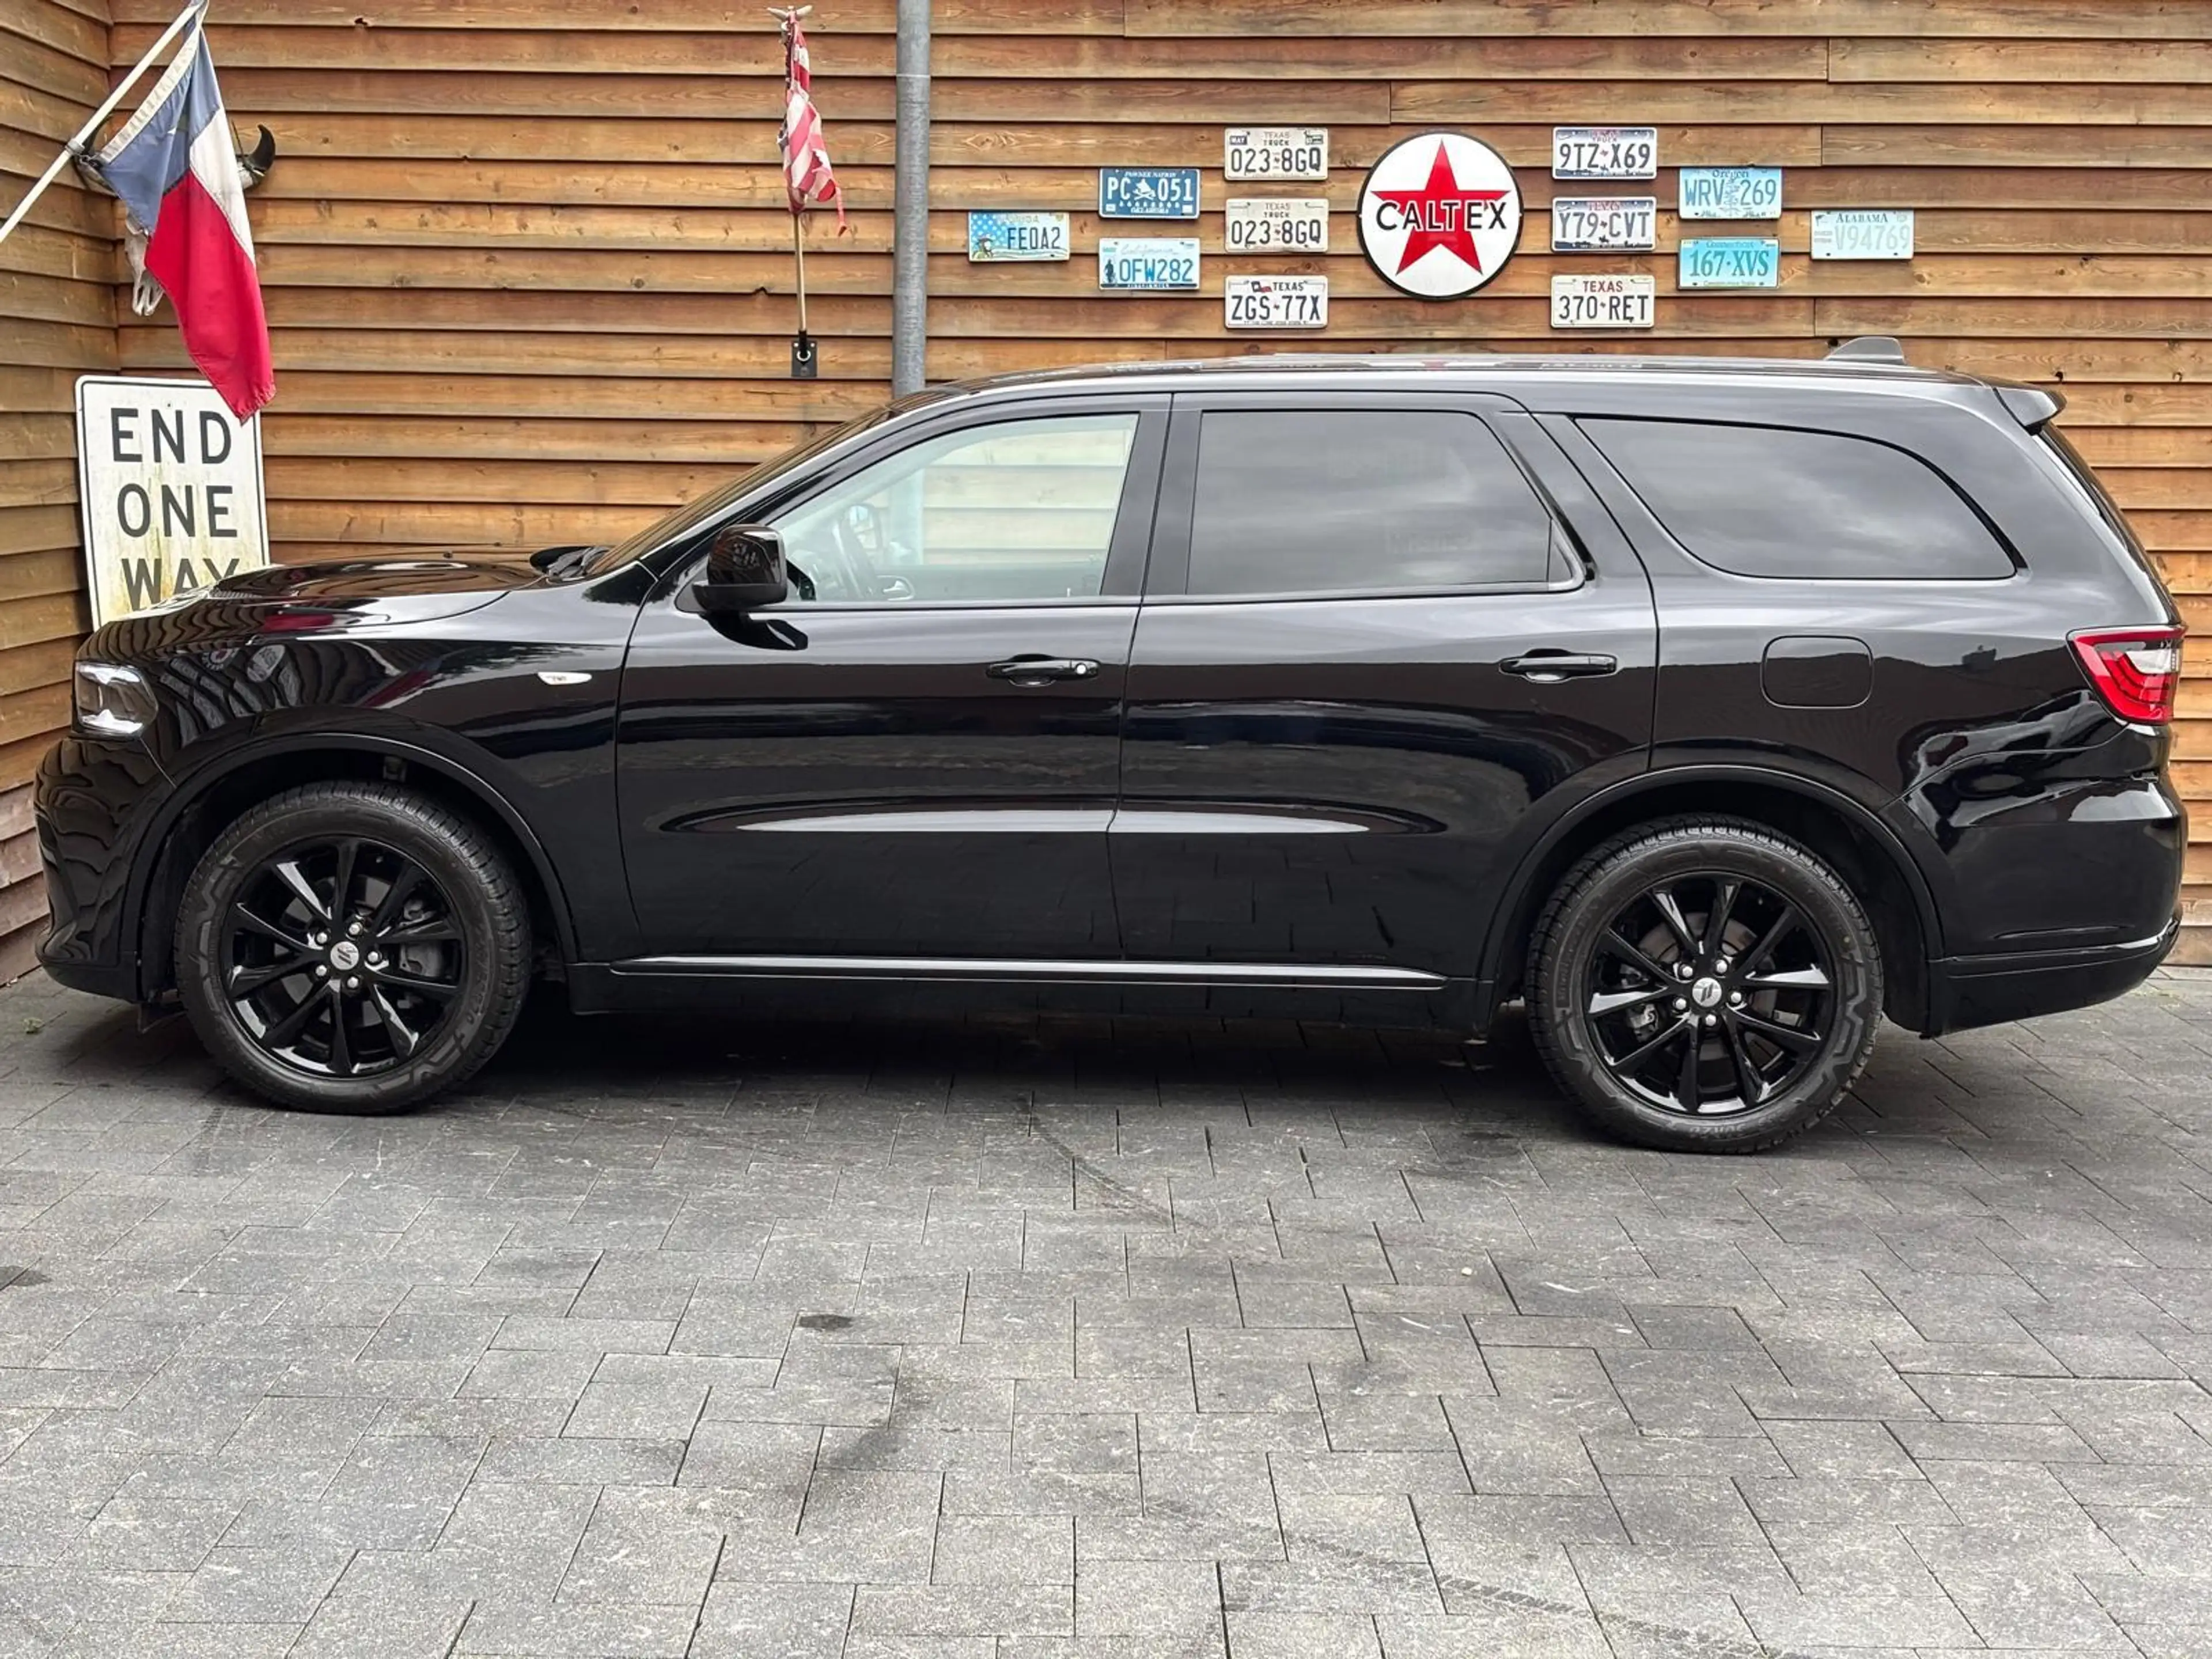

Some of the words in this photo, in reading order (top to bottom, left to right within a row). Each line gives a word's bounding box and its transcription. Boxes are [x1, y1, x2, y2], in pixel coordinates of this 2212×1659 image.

[1231, 147, 1270, 172] 023
[1281, 146, 1321, 172] 8GQ
[1559, 143, 1600, 169] 9TZ
[1609, 143, 1651, 169] X69
[1107, 176, 1131, 200] PC
[1157, 178, 1194, 202] 051
[1684, 179, 1725, 207] WRV
[1739, 179, 1777, 206] 269
[1376, 200, 1508, 232] CALTEX
[1558, 211, 1599, 238] Y79
[1608, 211, 1650, 238] CVT
[1836, 213, 1888, 224] ALABAMA
[1231, 219, 1271, 244] 023
[1281, 219, 1321, 244] 8GQ
[1272, 281, 1304, 291] TEXAS
[1582, 280, 1623, 293] TEXAS
[1231, 295, 1271, 321] ZGS
[1281, 295, 1321, 321] 77X
[1559, 294, 1598, 320] 370
[1608, 294, 1649, 321] RET
[111, 407, 232, 464] END
[118, 483, 238, 538] ONE
